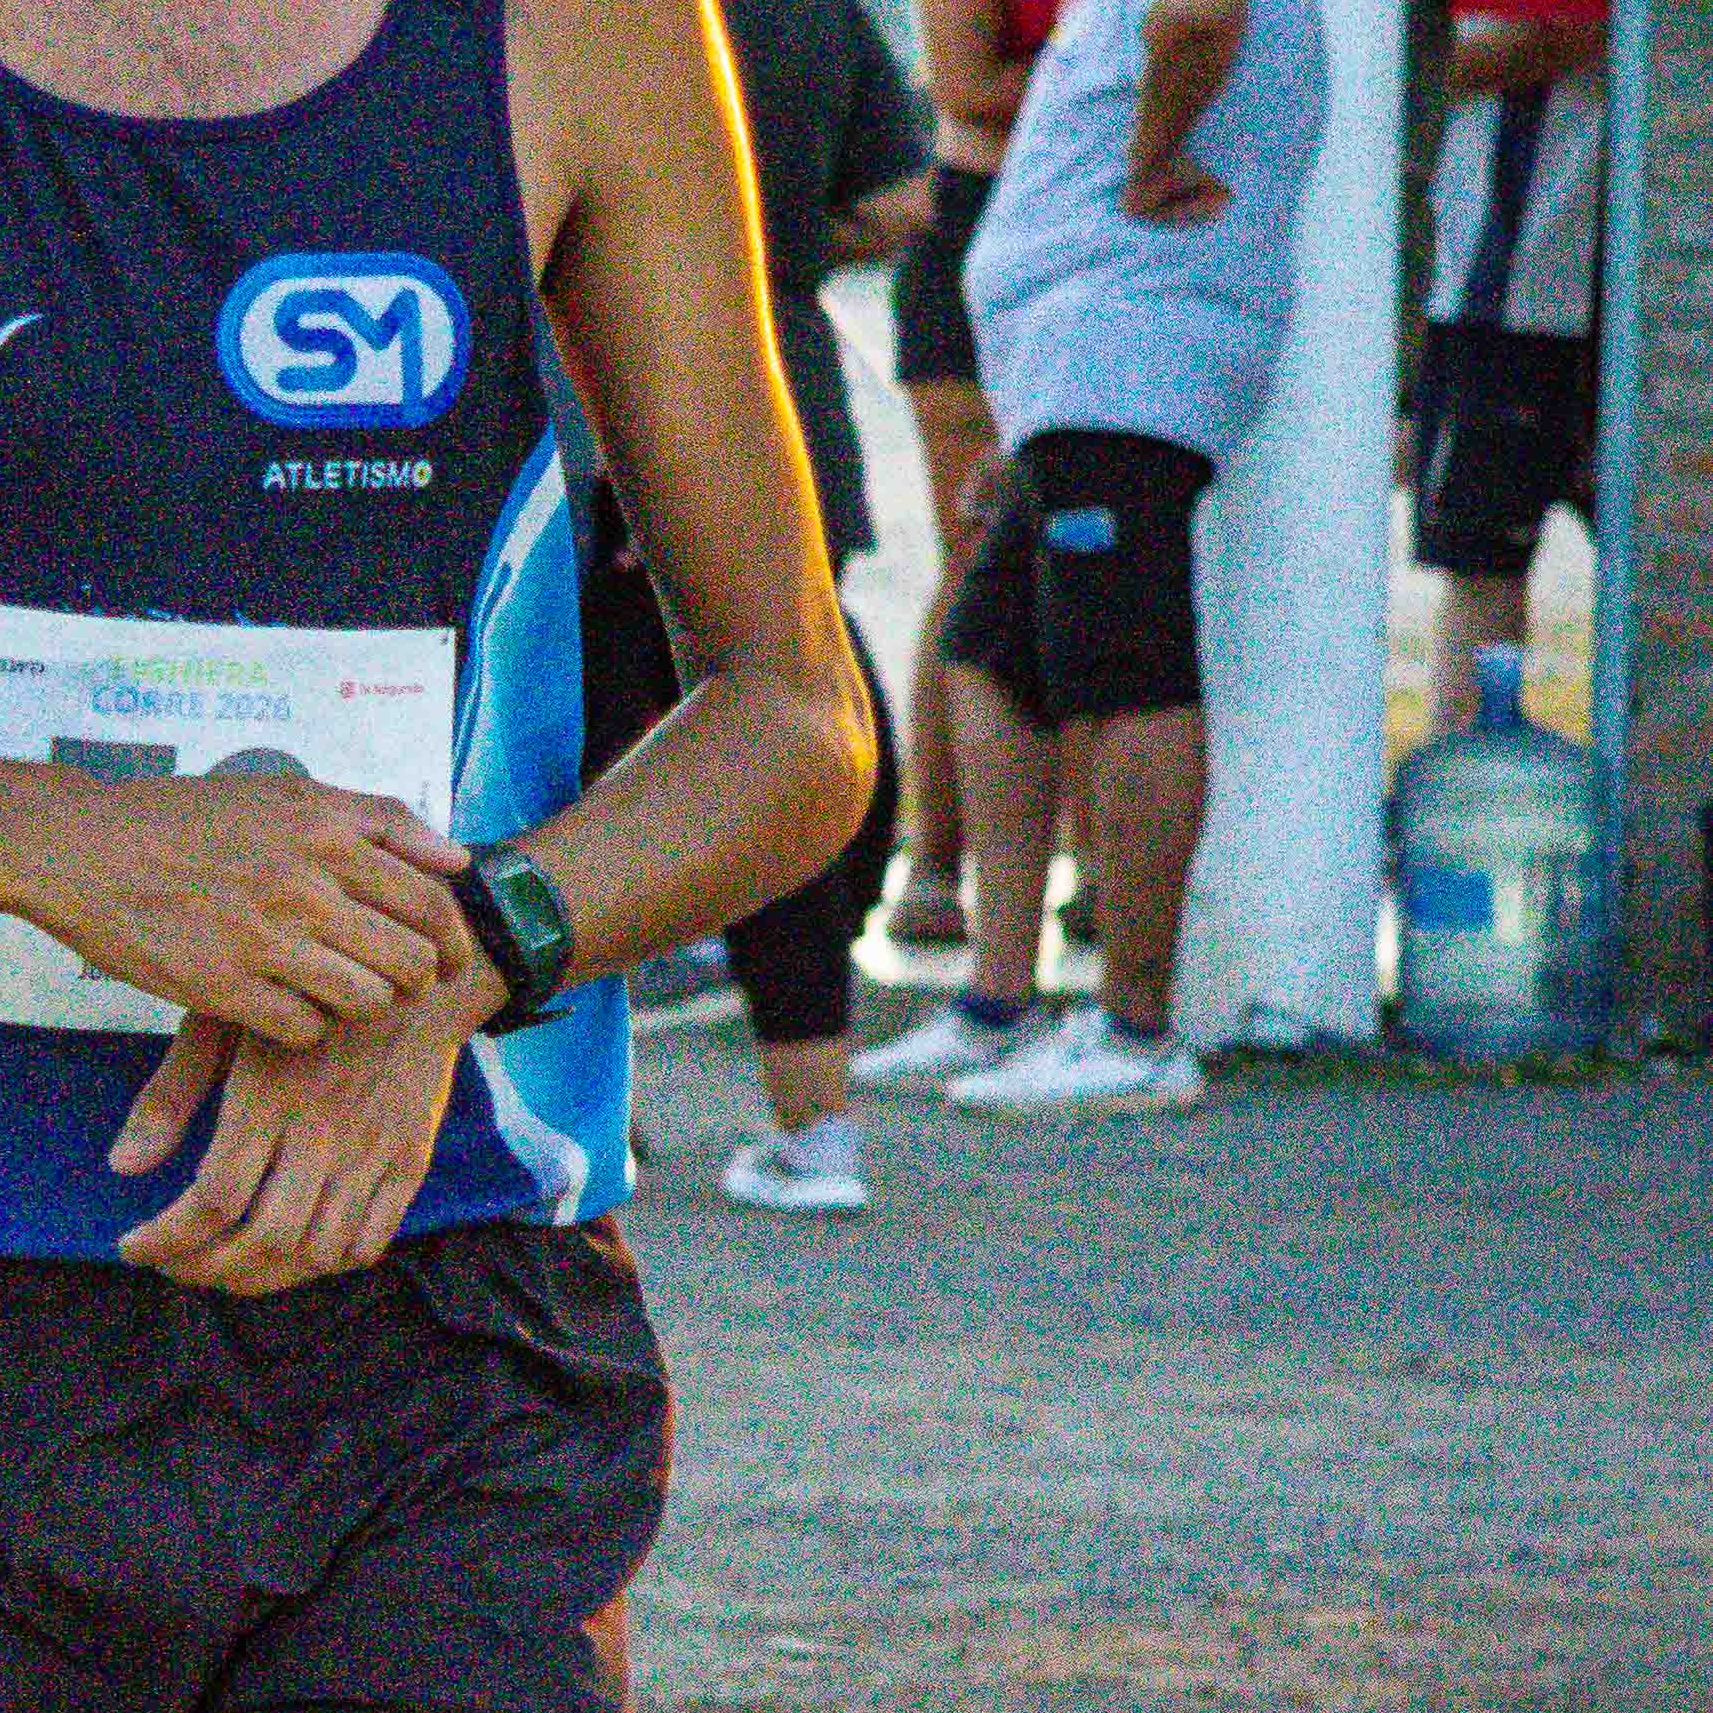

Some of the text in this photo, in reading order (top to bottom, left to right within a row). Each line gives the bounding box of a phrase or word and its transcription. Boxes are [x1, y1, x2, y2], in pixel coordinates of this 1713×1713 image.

[274, 289, 424, 408] SM
[262, 460, 433, 490] ATLETISMO
[91, 684, 292, 723] CORRE 2026
